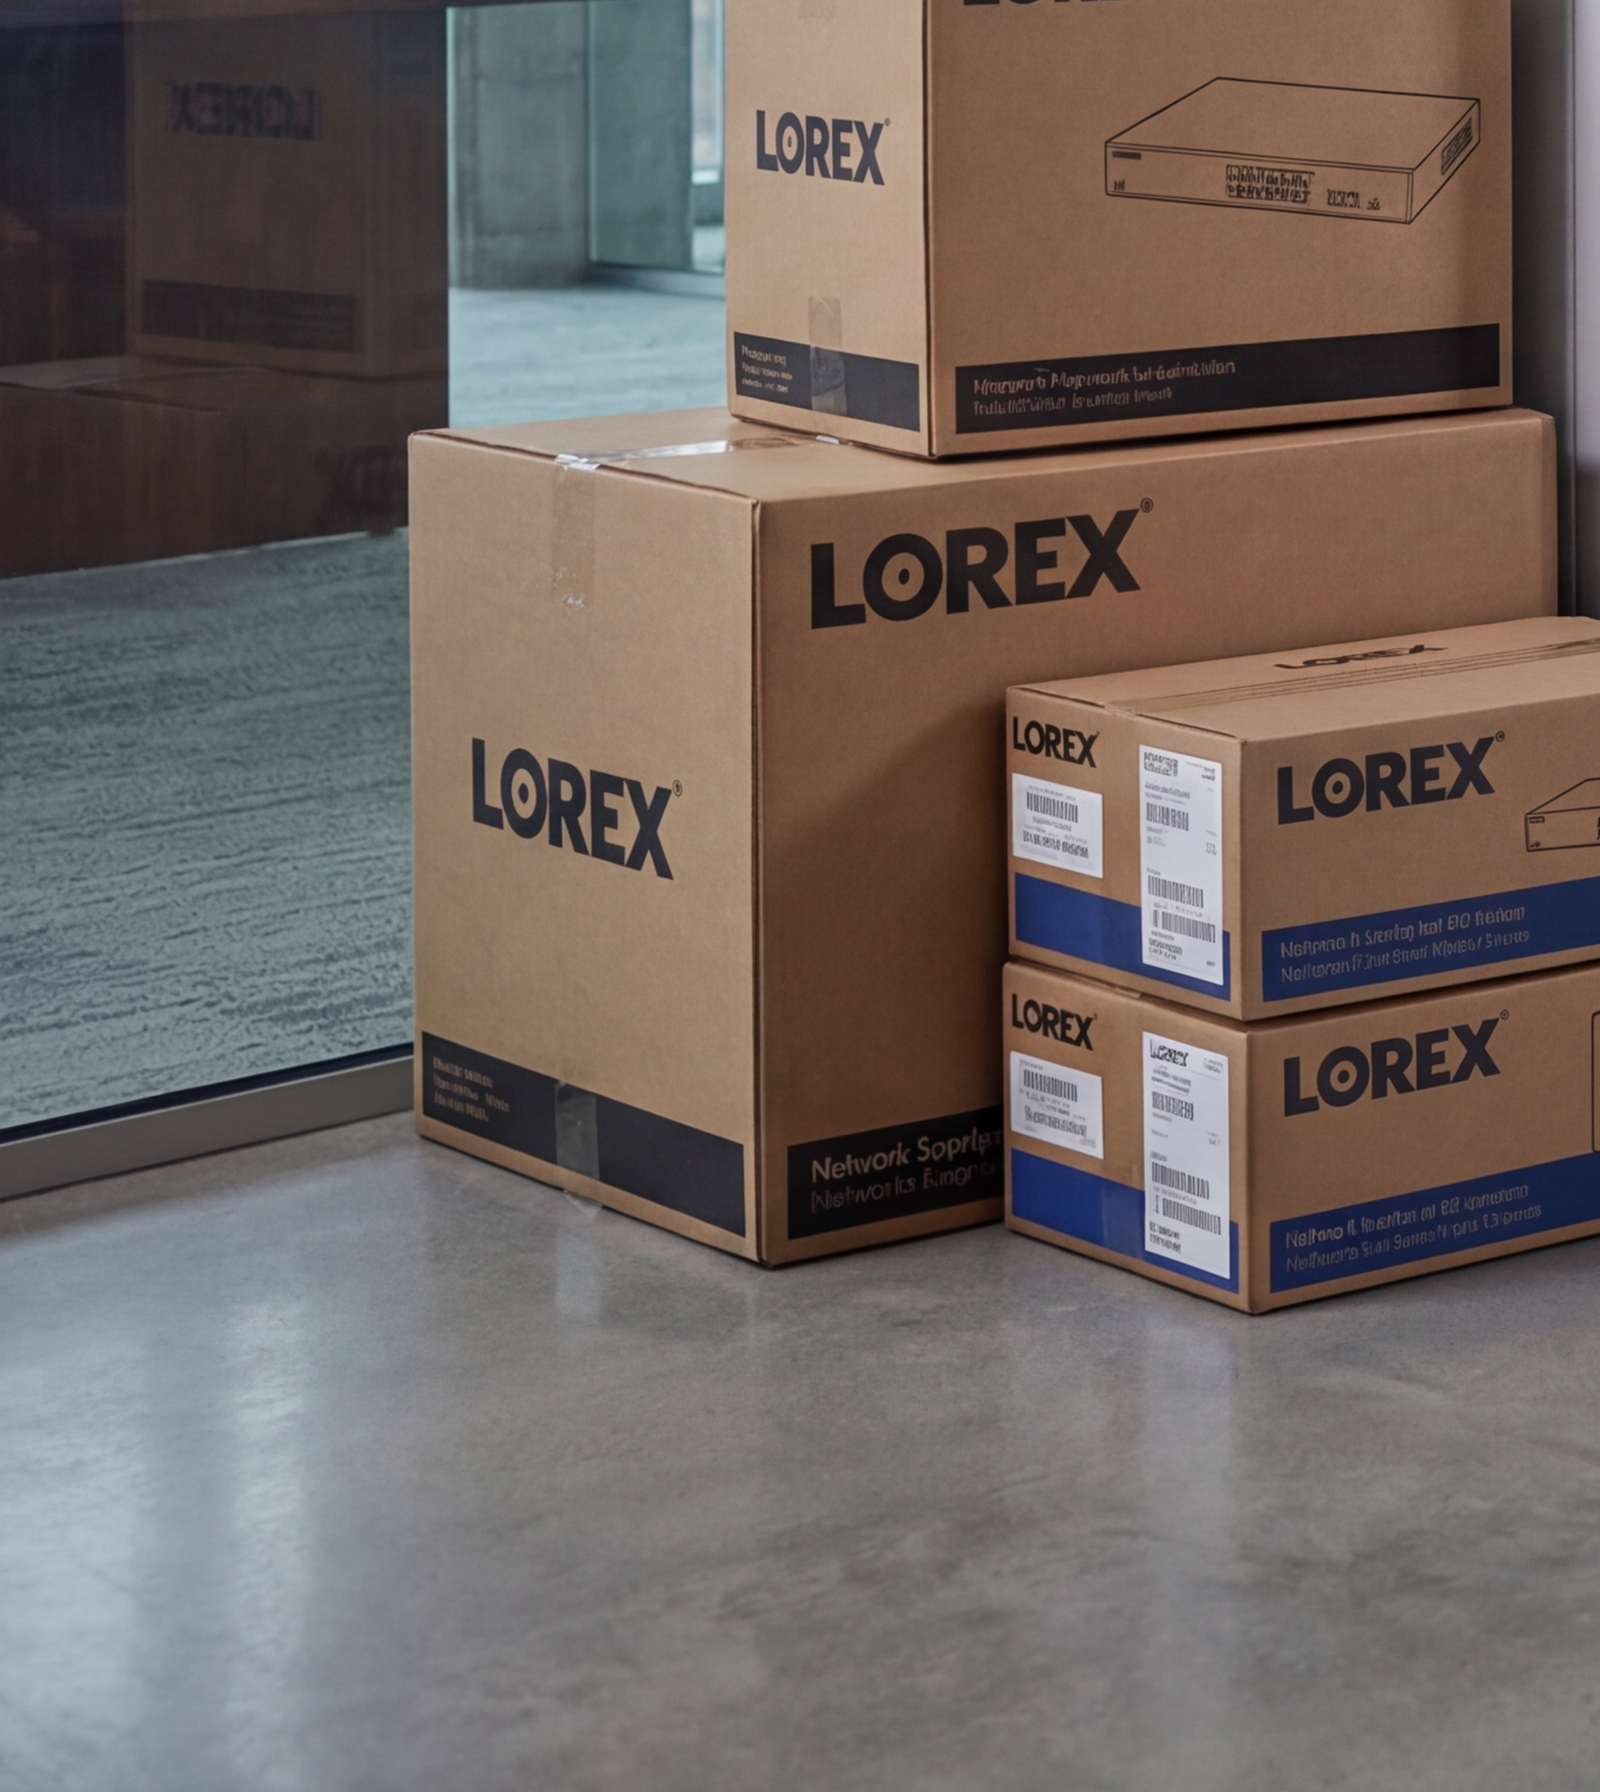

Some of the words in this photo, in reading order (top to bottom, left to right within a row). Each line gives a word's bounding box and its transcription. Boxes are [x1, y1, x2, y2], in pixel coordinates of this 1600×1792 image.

[755, 109, 886, 186] LOREX
[810, 508, 1142, 631] LOREX
[1012, 715, 1096, 768] LOREX
[1277, 736, 1496, 826] LOREX
[471, 737, 674, 881] LOREX
[1011, 992, 1094, 1052] LOREX
[1283, 1017, 1501, 1118] LOREX
[811, 1141, 911, 1184] Network
